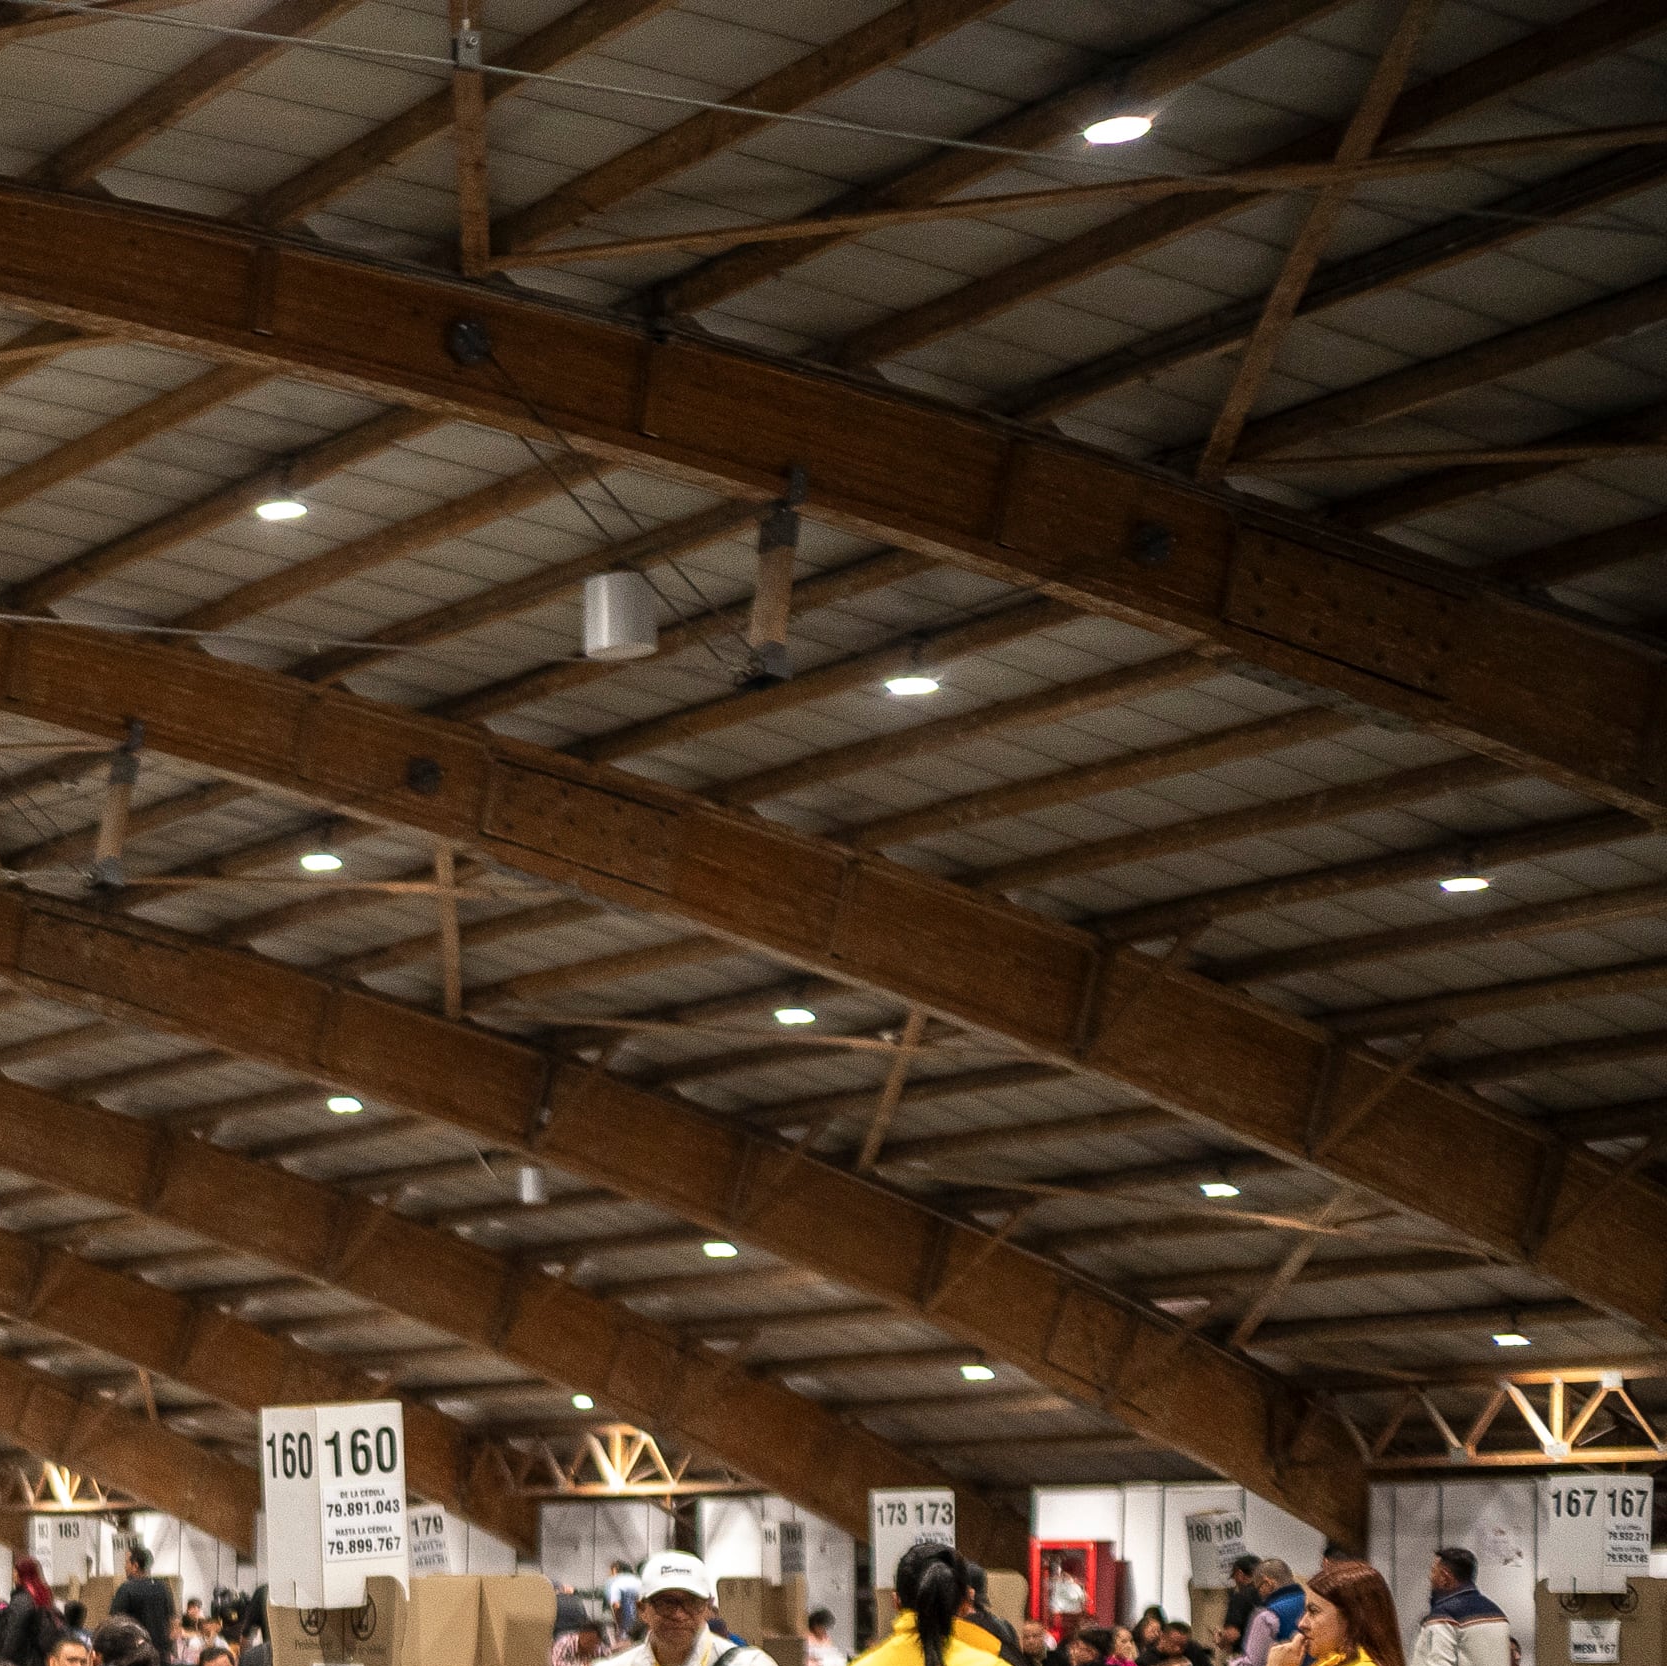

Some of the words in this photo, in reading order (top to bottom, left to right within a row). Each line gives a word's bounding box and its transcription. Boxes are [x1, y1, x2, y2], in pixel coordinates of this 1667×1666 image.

[267, 1432, 313, 1479] 160
[325, 1426, 398, 1477] 160
[350, 1489, 359, 1498] LA
[1552, 1489, 1598, 1518] 167
[1607, 1489, 1649, 1518] 167
[326, 1499, 400, 1518] 79.891.043
[877, 1502, 907, 1526] 173
[916, 1502, 954, 1526] 173
[335, 1527, 356, 1536] HASTA
[358, 1526, 366, 1535] LA
[411, 1515, 444, 1536] 179
[1215, 1520, 1243, 1539] 180
[328, 1536, 401, 1555] 79.899.767
